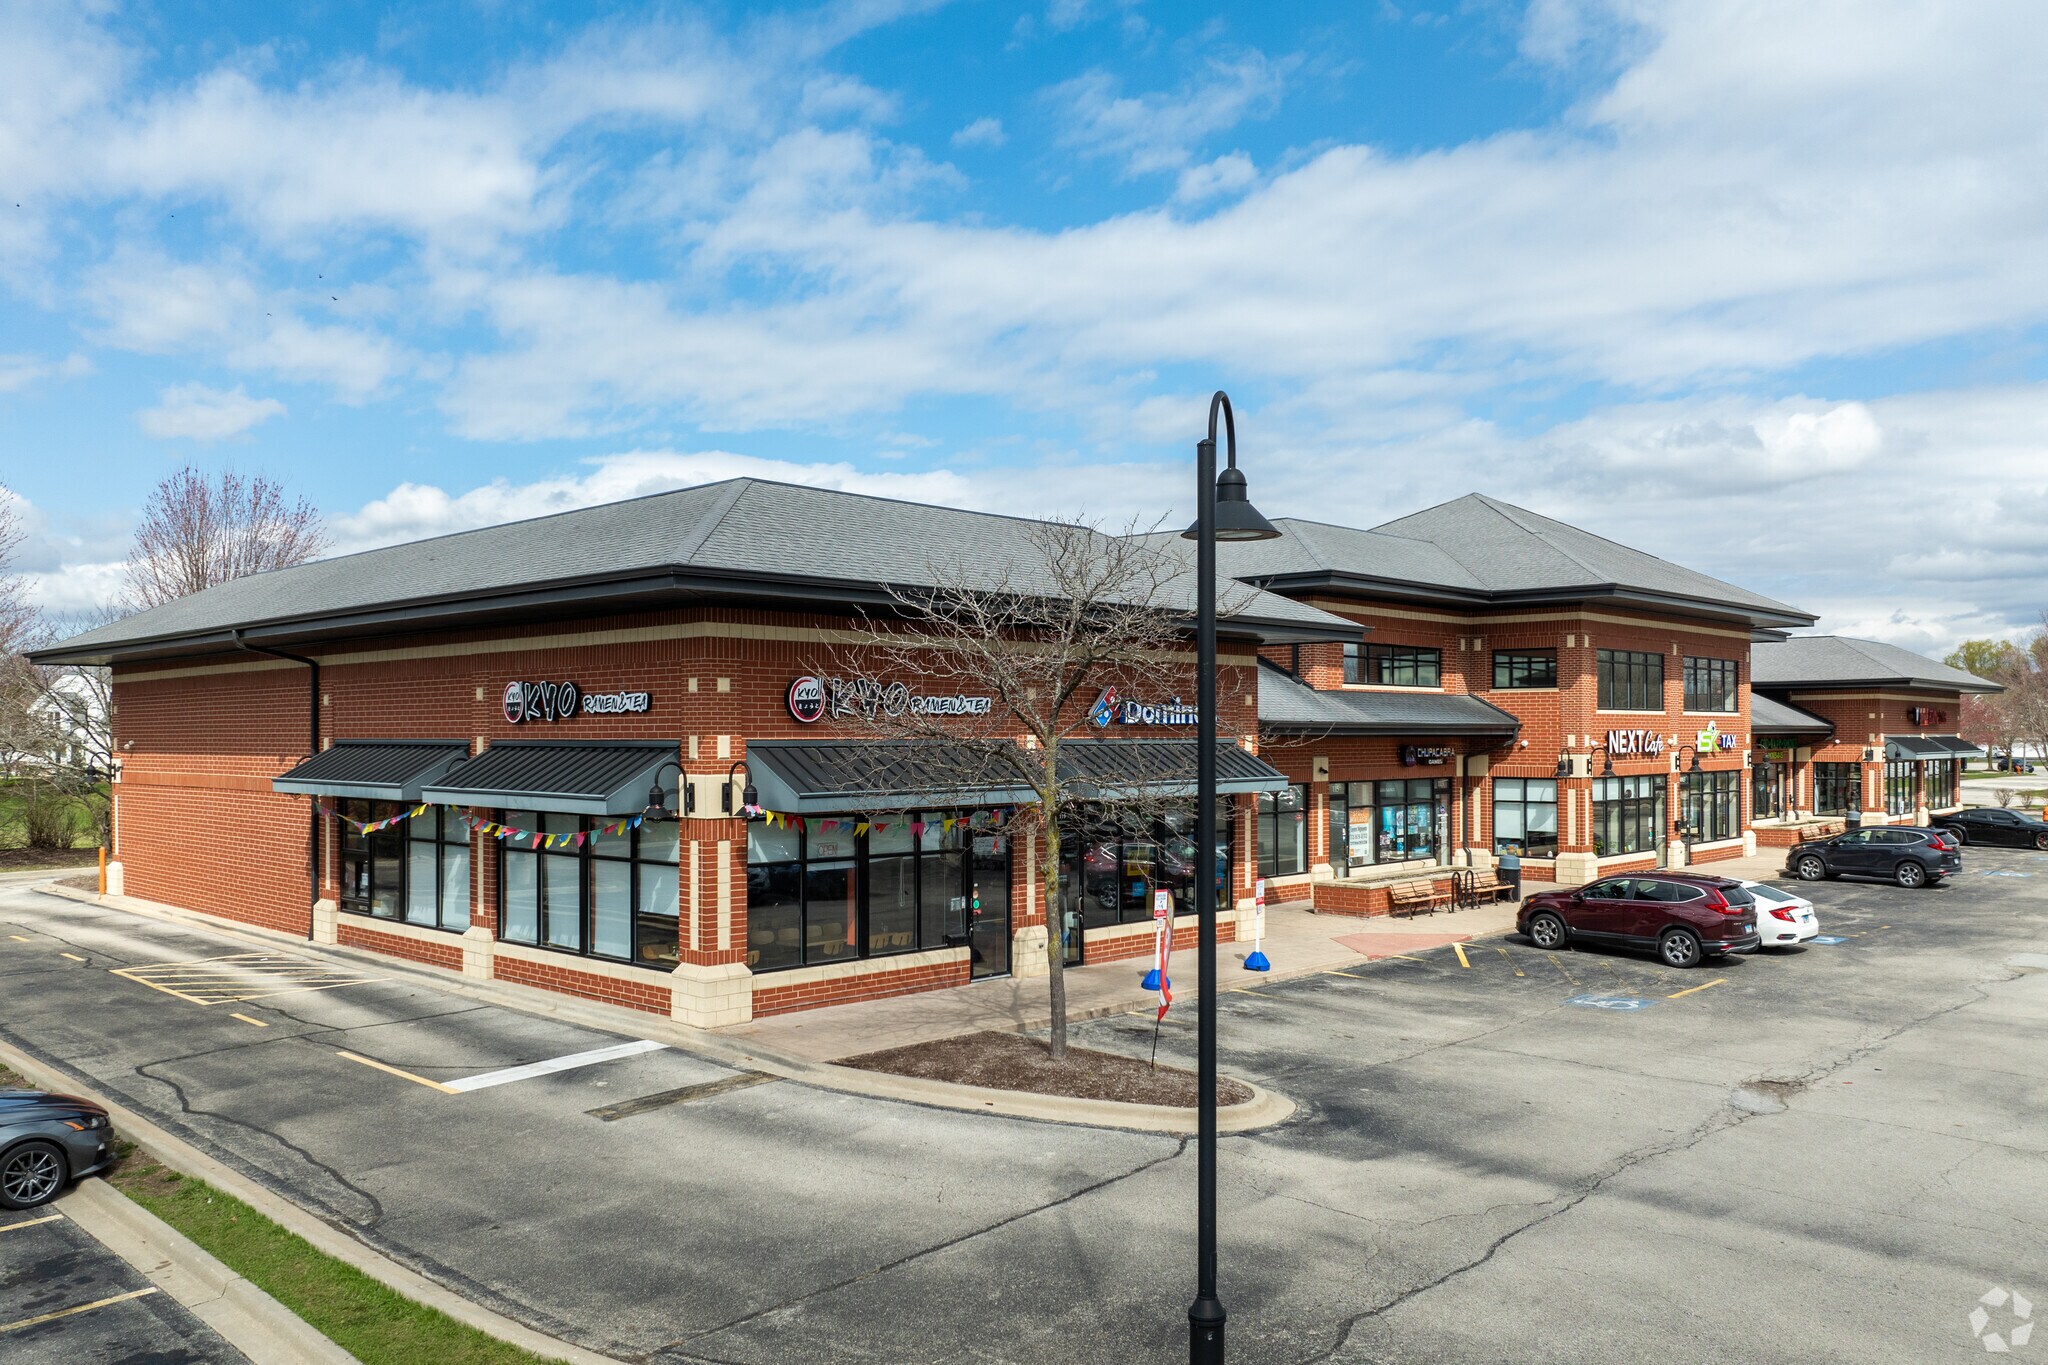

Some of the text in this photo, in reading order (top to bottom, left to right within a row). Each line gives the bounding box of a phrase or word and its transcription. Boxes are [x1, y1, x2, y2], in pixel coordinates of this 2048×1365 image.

[508, 692, 520, 701] KYO
[524, 681, 577, 721] KYO
[797, 688, 818, 699] KYO
[832, 677, 909, 721] KYO
[1125, 697, 1217, 724] Domin
[1609, 730, 1664, 756] NEXT Cafe
[1721, 734, 1737, 748] TAX
